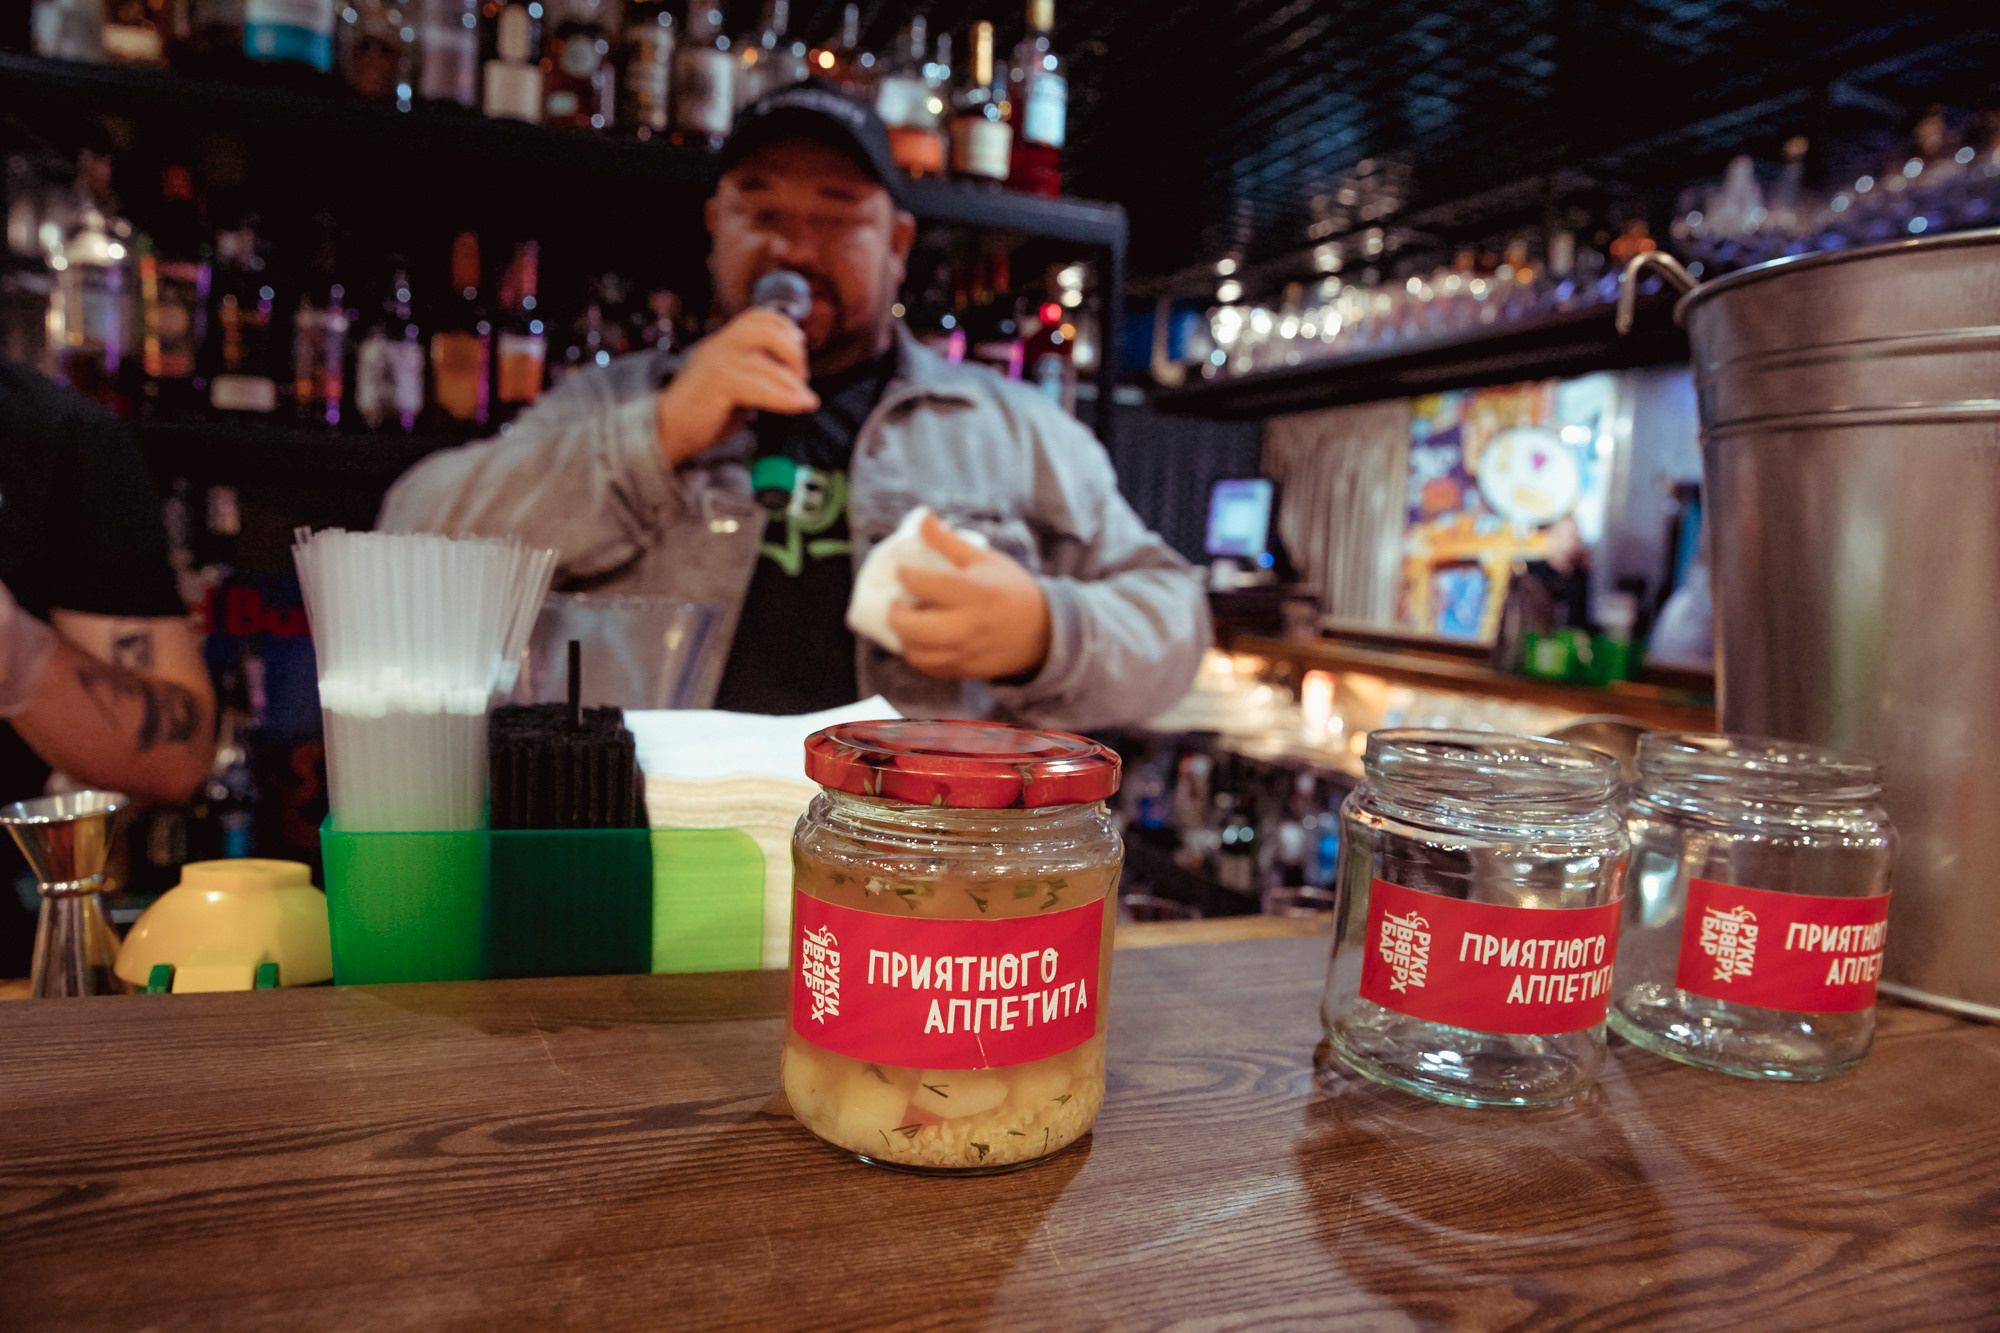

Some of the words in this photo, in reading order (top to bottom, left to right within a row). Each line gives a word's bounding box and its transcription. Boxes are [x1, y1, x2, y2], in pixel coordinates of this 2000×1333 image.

[1379, 920, 1397, 963] БАР
[1389, 925, 1414, 994] ВВЕРХ
[1407, 930, 1431, 988] РУКИ
[1459, 931, 1606, 970] ПРИЯТНОГО
[1699, 915, 1721, 956] БАР
[1712, 920, 1740, 984] ВВЕРХ
[1733, 923, 1759, 976] РУКИ
[1785, 920, 1888, 953] ПРИЯТНОГ
[802, 938, 813, 988] БАР
[811, 942, 826, 1025] ВВЕРХ
[824, 948, 840, 1017] РУКИ
[867, 947, 1059, 992] ПРИЯТНОГО
[923, 978, 1088, 1034] АППЕТИТА
